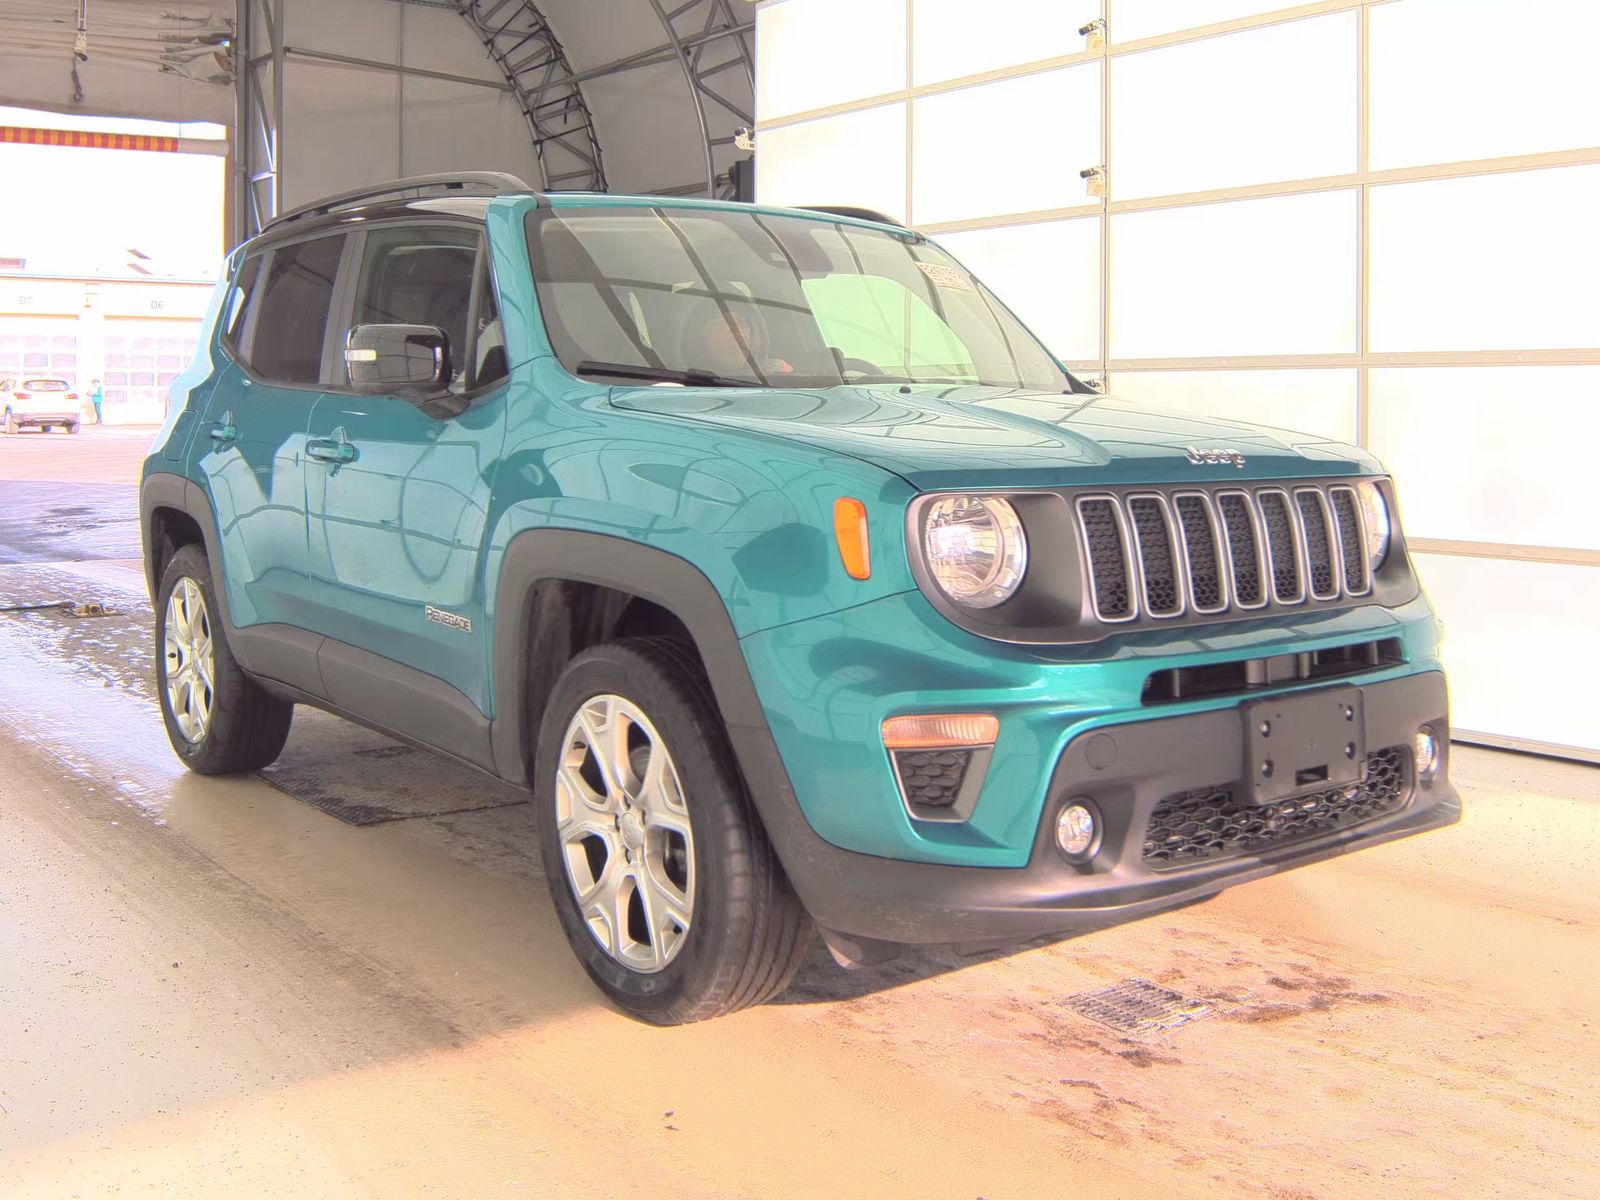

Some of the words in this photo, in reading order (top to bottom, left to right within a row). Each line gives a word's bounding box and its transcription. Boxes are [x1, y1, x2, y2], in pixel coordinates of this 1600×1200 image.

[151, 300, 164, 309] D6
[1184, 446, 1246, 468] Jeep
[425, 605, 472, 633] RENEGADE
